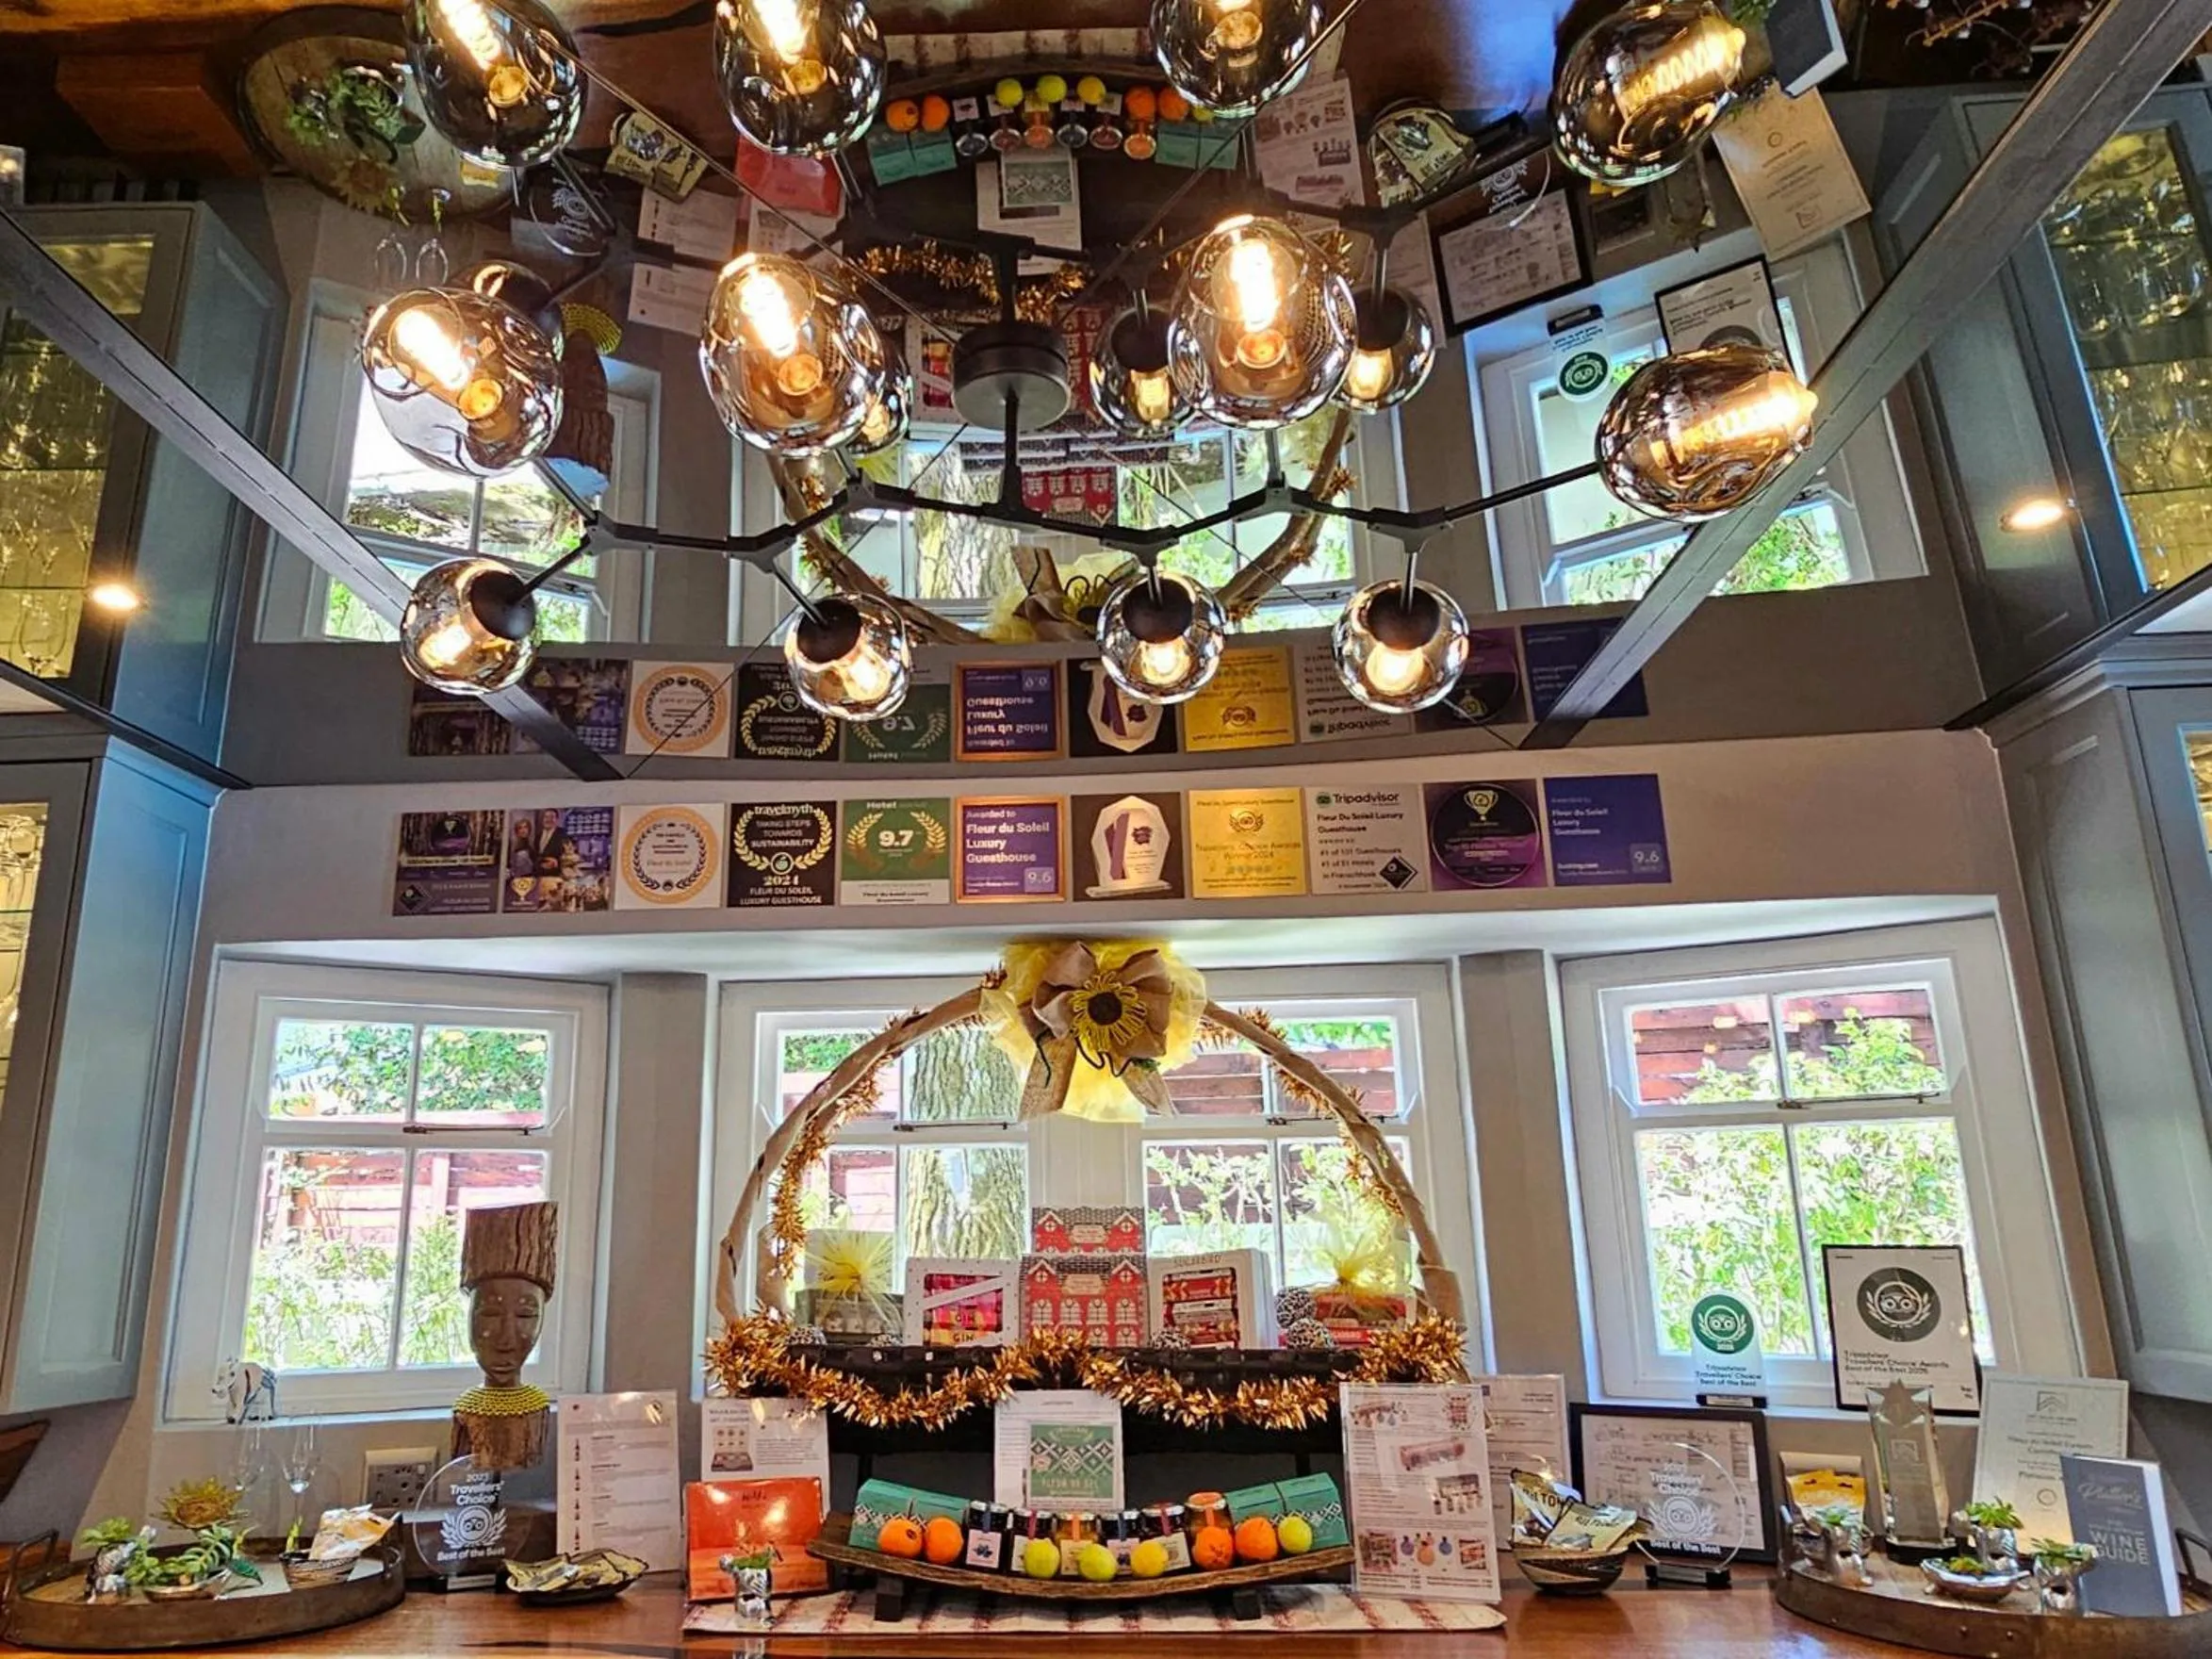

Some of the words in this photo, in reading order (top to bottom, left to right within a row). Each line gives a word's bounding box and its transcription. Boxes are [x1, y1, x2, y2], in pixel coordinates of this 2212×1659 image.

[1333, 792, 1400, 804] Tripadvisor
[754, 803, 813, 818] travelmyth
[966, 823, 997, 834] Fleur
[998, 822, 1014, 833] du
[1017, 822, 1050, 832] Soleil
[878, 830, 914, 847] 9.7
[966, 839, 1007, 850] Luxury
[966, 851, 1037, 863] Guesthouse
[1633, 850, 1660, 863] 9.6
[1027, 871, 1052, 884] 9.6
[953, 1334, 974, 1342] GIN
[456, 1493, 498, 1505] Choice
[2089, 1530, 2146, 1552] WINE
[437, 1551, 458, 1562] Best
[2095, 1543, 2150, 1565] GUIDE
